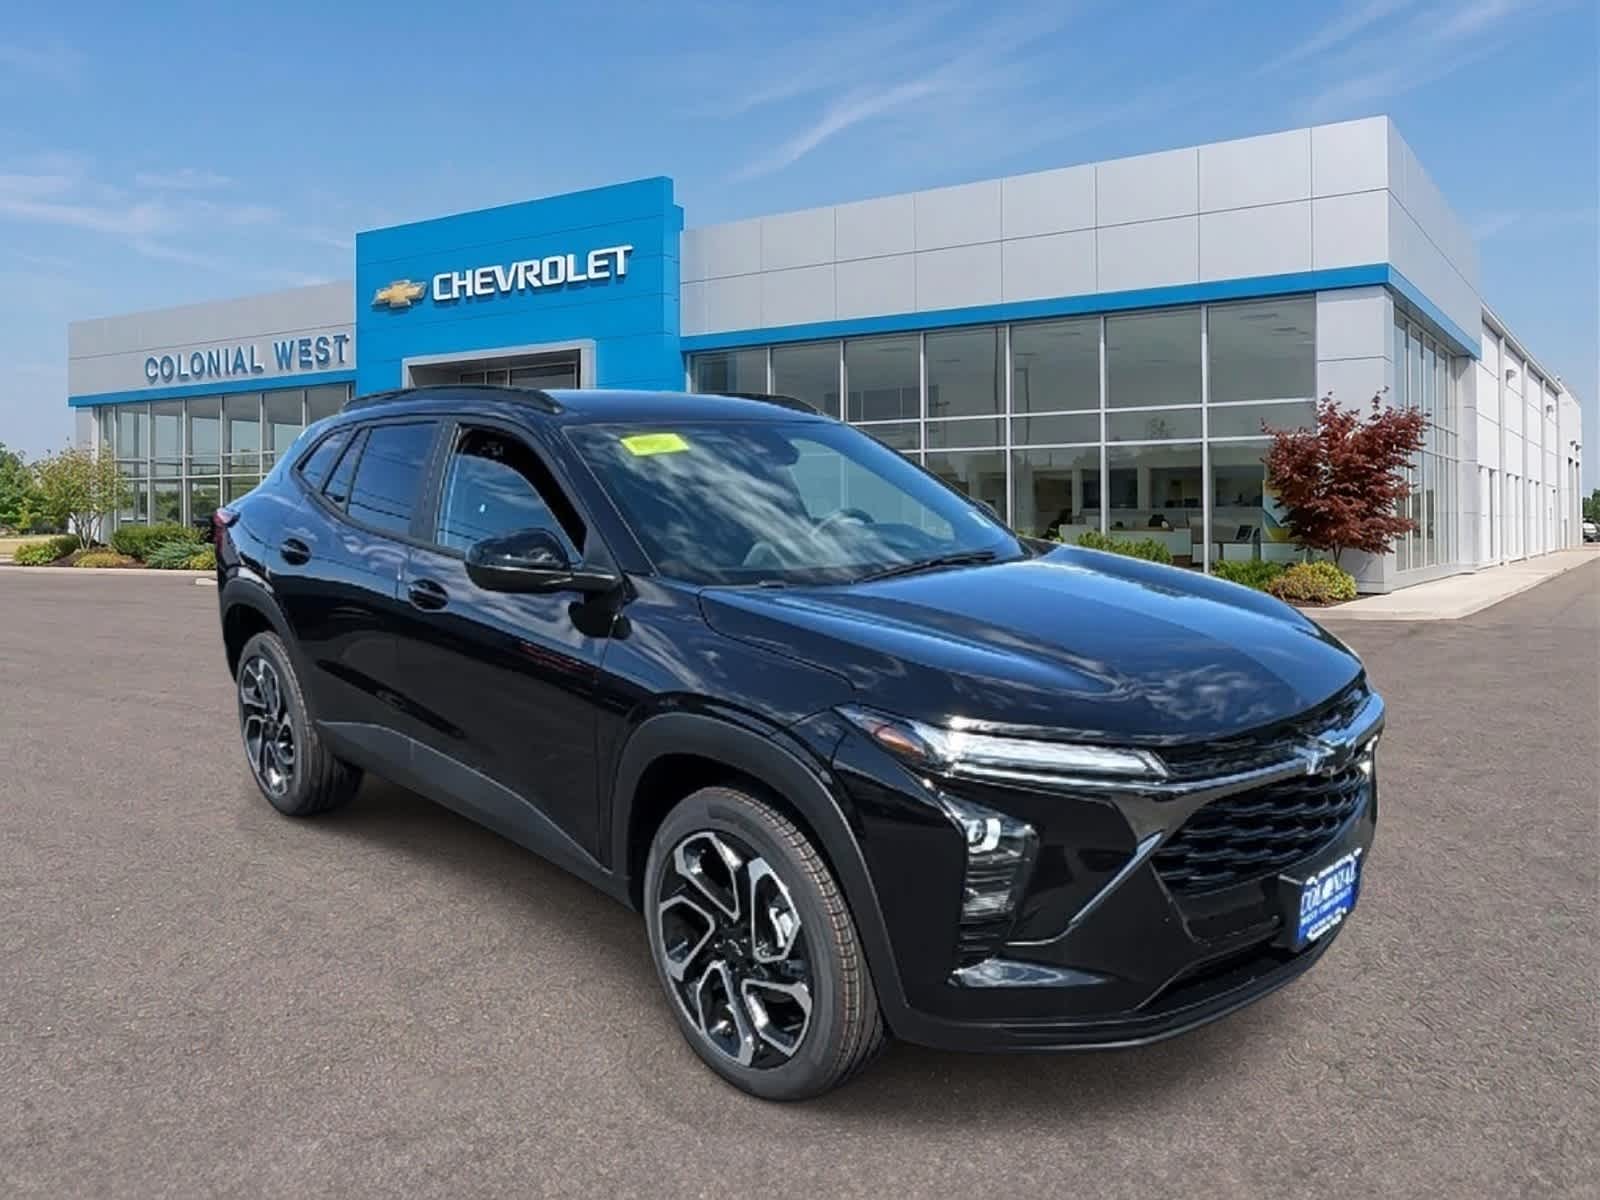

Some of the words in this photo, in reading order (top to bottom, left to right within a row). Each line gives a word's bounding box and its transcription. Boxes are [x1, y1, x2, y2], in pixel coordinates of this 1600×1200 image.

[433, 244, 633, 301] CHEVROLET
[145, 346, 264, 383] COLONIAL
[274, 334, 350, 370] WEST
